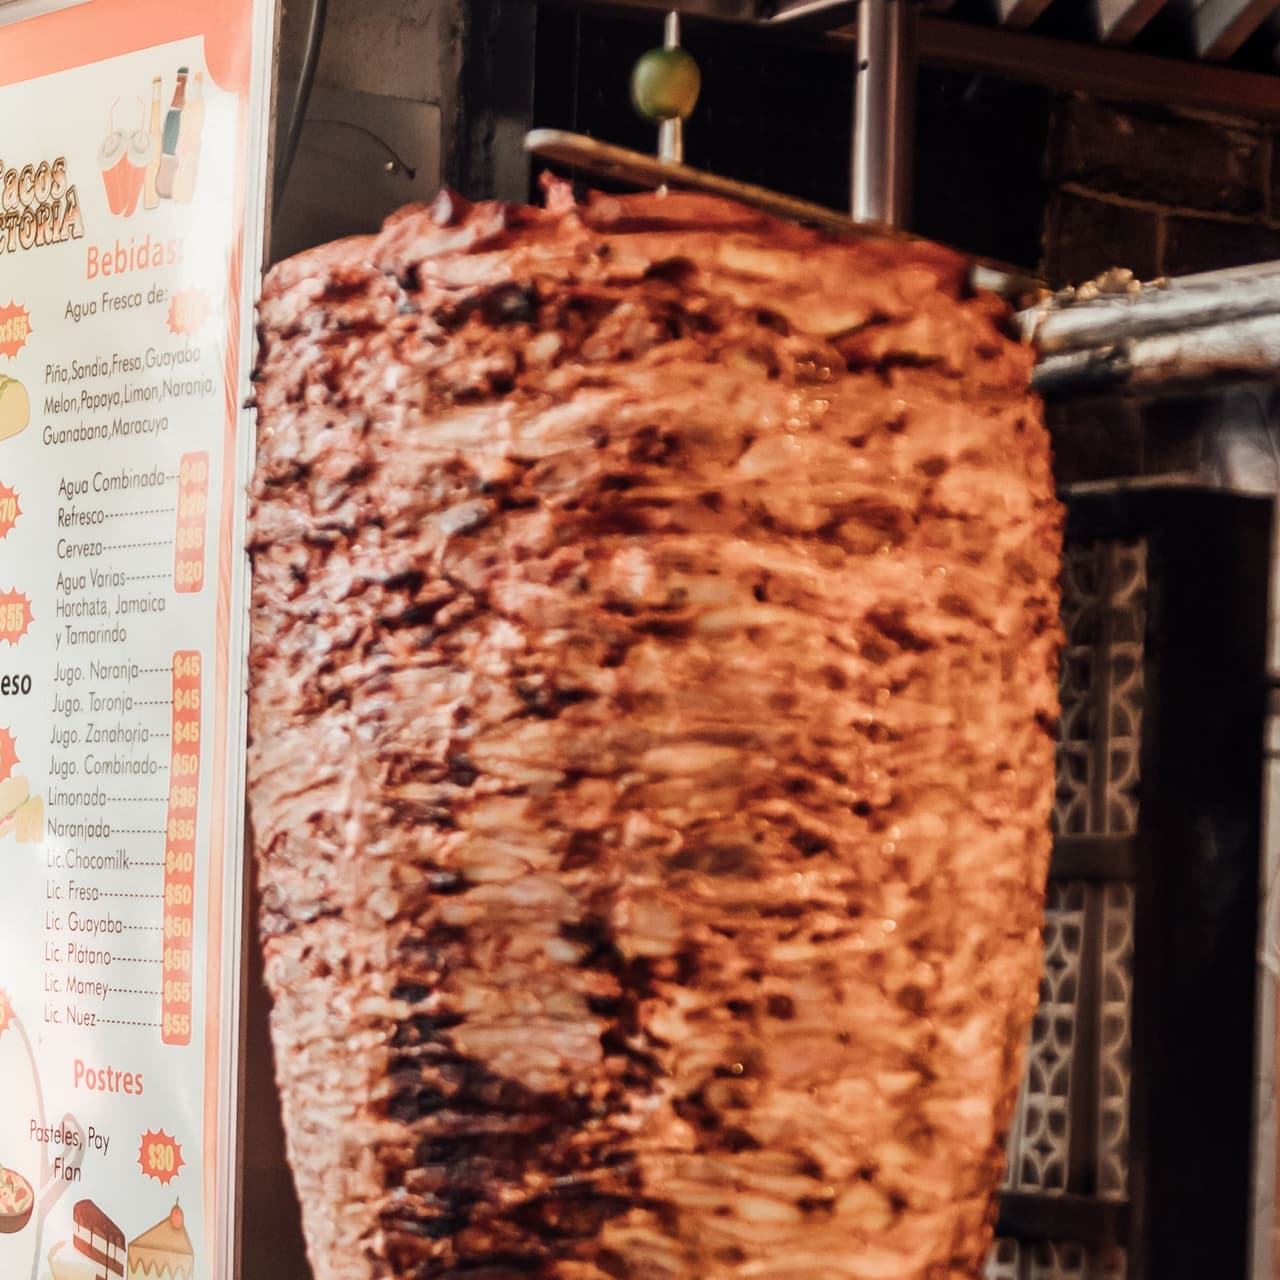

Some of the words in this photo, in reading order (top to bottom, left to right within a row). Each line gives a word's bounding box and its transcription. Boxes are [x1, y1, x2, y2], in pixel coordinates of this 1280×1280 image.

[65, 299, 97, 323] Agua
[102, 291, 142, 313] Fresca
[147, 282, 168, 303] de:
[58, 477, 89, 501] Agua
[92, 464, 165, 493] Combinada
[58, 504, 105, 527] Refresco
[57, 538, 103, 559] Cerveza
[56, 572, 86, 596] Agua
[90, 566, 126, 588] Varias
[56, 597, 111, 619] Horchata,
[115, 591, 166, 614] Jamaica
[55, 631, 62, 650] y
[65, 622, 127, 646] Tamarindo
[90, 657, 139, 684] Naranja
[174, 655, 200, 680] $45
[88, 690, 133, 716] Toronja
[174, 688, 200, 712] $45
[85, 722, 149, 744] Zanahoria
[174, 720, 199, 745] $45
[84, 753, 158, 775] Combinado
[172, 752, 199, 777] $50
[48, 785, 107, 807] Limonada
[47, 817, 111, 842] Naranjada
[166, 850, 193, 874] $40
[68, 880, 99, 901] Fresa
[165, 881, 192, 906] $50
[68, 911, 123, 936] Guayaba
[164, 914, 191, 939] $50
[68, 942, 112, 966] Plátano
[66, 975, 109, 1001] Mamey
[66, 1005, 96, 1027] Nuez
[74, 1058, 144, 1096] Postres
[30, 1119, 83, 1151] Pasteles,
[88, 1126, 110, 1156] Pay
[54, 1157, 81, 1182] Flan
[148, 1143, 175, 1172] $30
